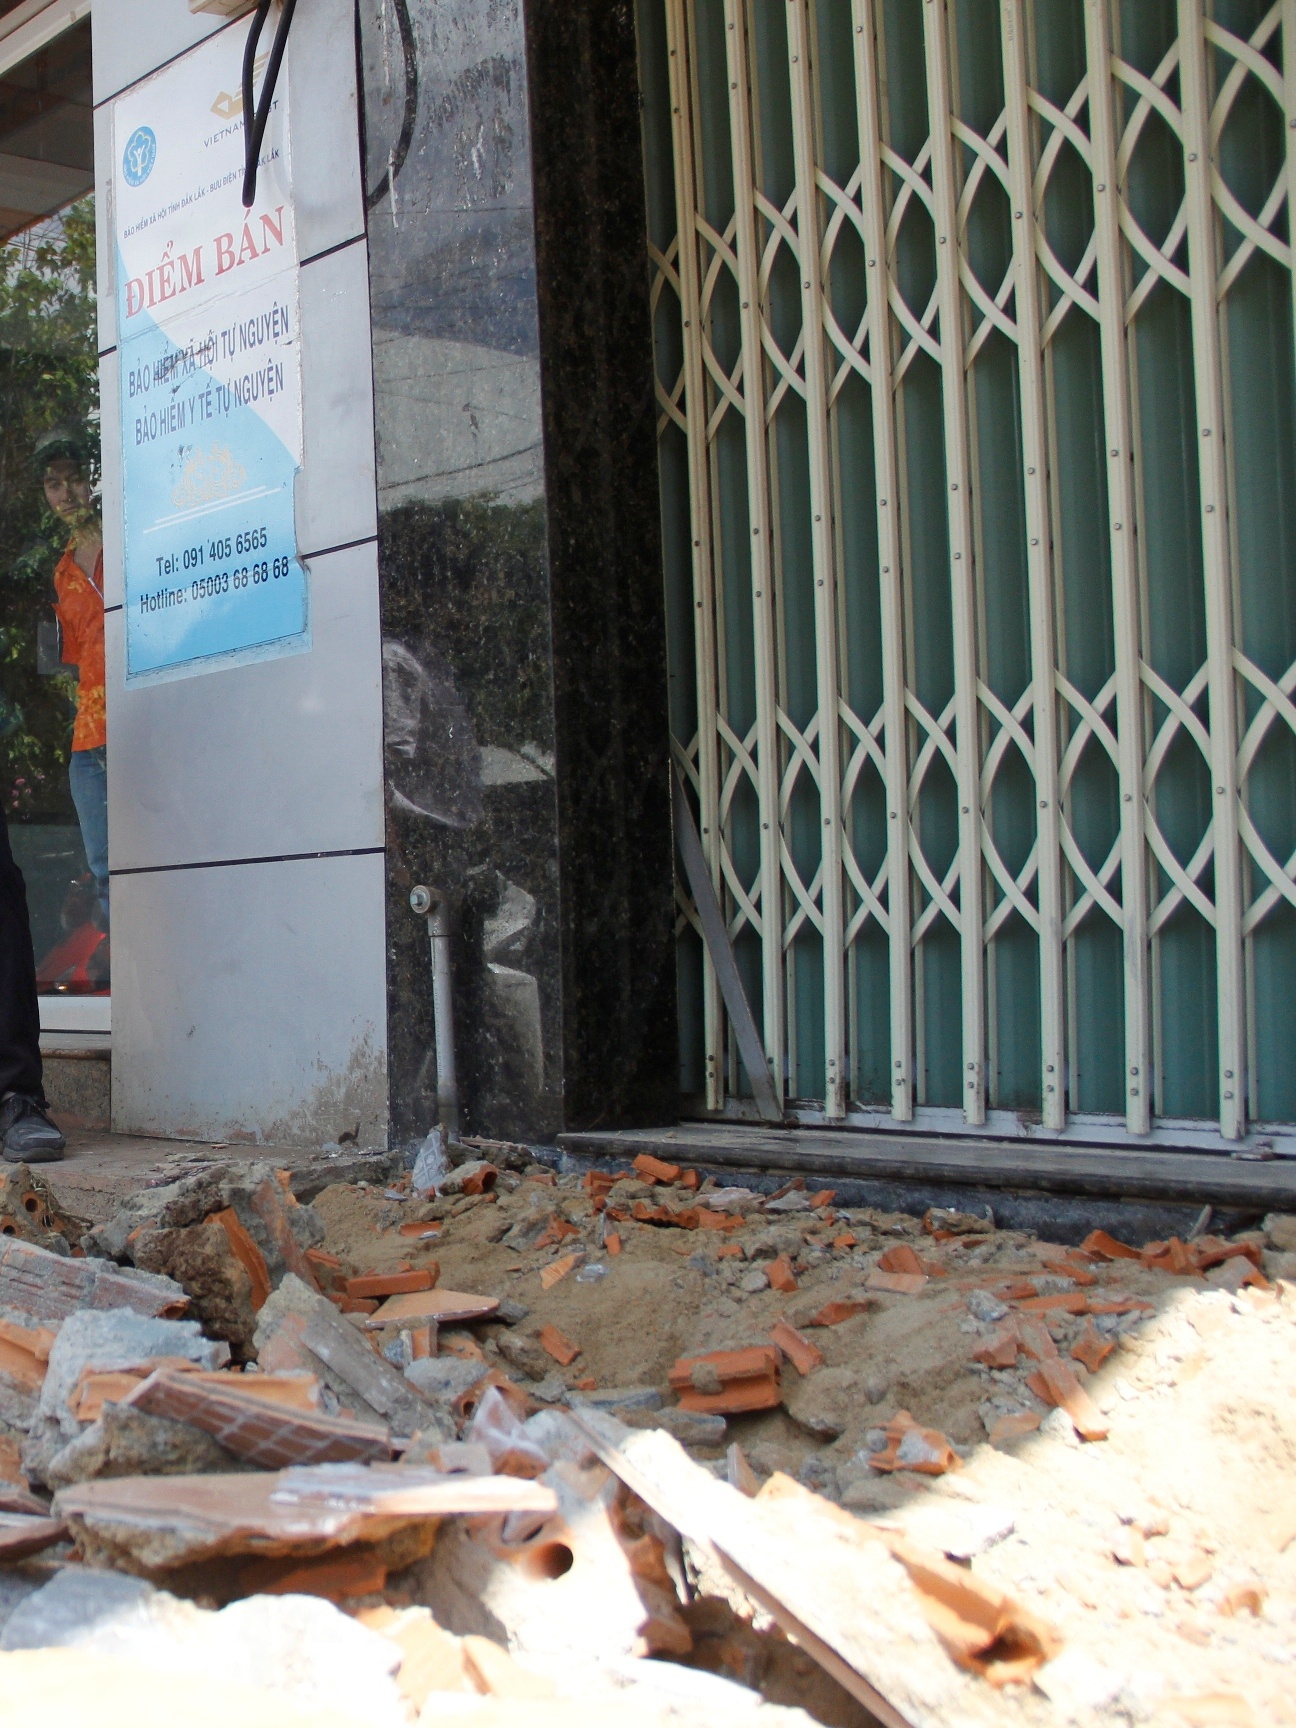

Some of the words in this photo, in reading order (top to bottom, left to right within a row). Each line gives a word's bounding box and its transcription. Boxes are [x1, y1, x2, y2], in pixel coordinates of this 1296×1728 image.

[124, 240, 204, 319] ĐIỂM
[213, 206, 284, 276] BÁN
[129, 358, 150, 398] BẢO
[153, 340, 178, 388] HIỂM
[181, 338, 196, 376] XÃ
[199, 329, 218, 371] HỘI
[221, 322, 236, 362] TỰ
[239, 301, 289, 352] NGUYỆN
[135, 405, 157, 446] BẢO
[188, 396, 196, 424] Y
[198, 377, 212, 421] TẾ
[216, 378, 231, 418] TỰ
[234, 358, 284, 408] NGUYỆN
[140, 588, 187, 614] Hotline:
[192, 573, 229, 601] 05003
[233, 567, 248, 589] 68
[253, 561, 268, 584] 68
[273, 556, 289, 579] 68
[156, 554, 179, 577] Tel:
[183, 545, 204, 569] 091
[209, 537, 232, 561] 405
[236, 527, 267, 554] 6565
